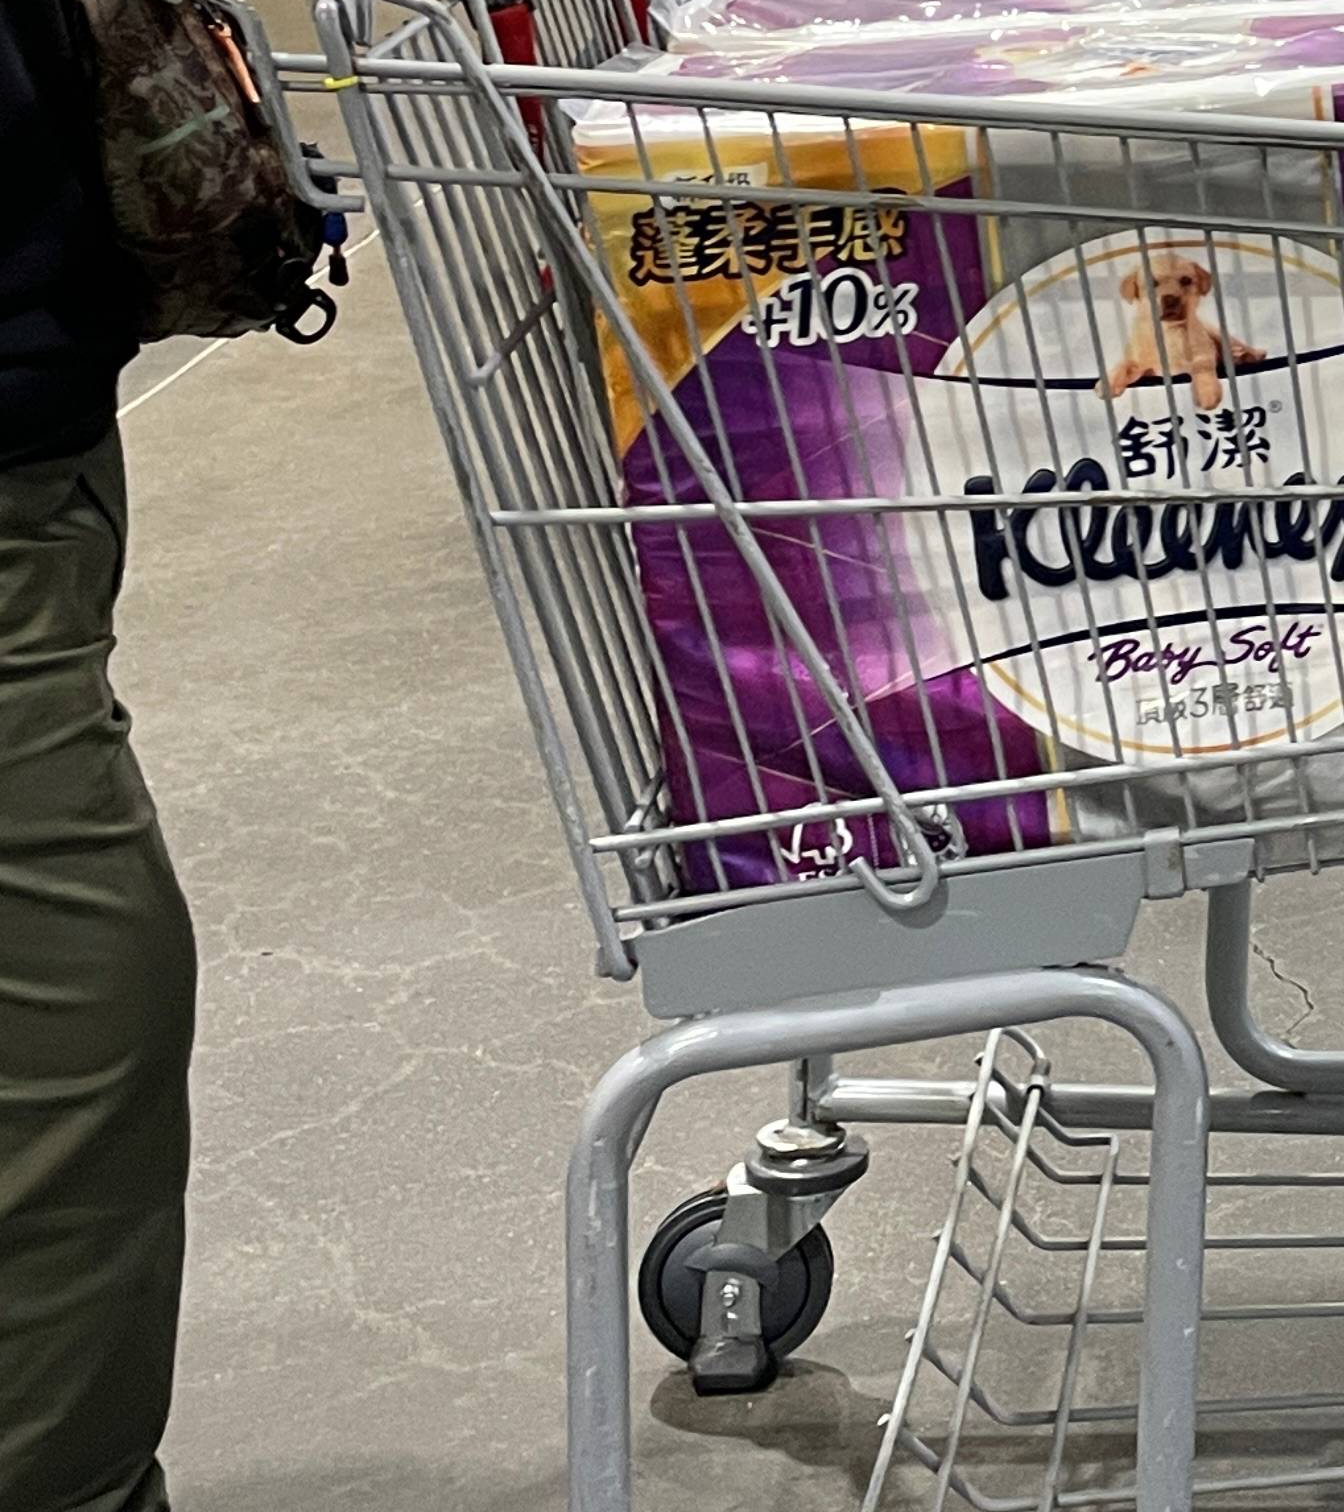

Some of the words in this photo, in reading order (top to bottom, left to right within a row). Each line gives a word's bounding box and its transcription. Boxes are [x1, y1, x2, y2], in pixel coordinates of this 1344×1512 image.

[756, 273, 912, 340] +10%
[1117, 407, 1271, 479] 舒潔
[1088, 639, 1203, 685] Baby
[1223, 621, 1322, 674] Soft
